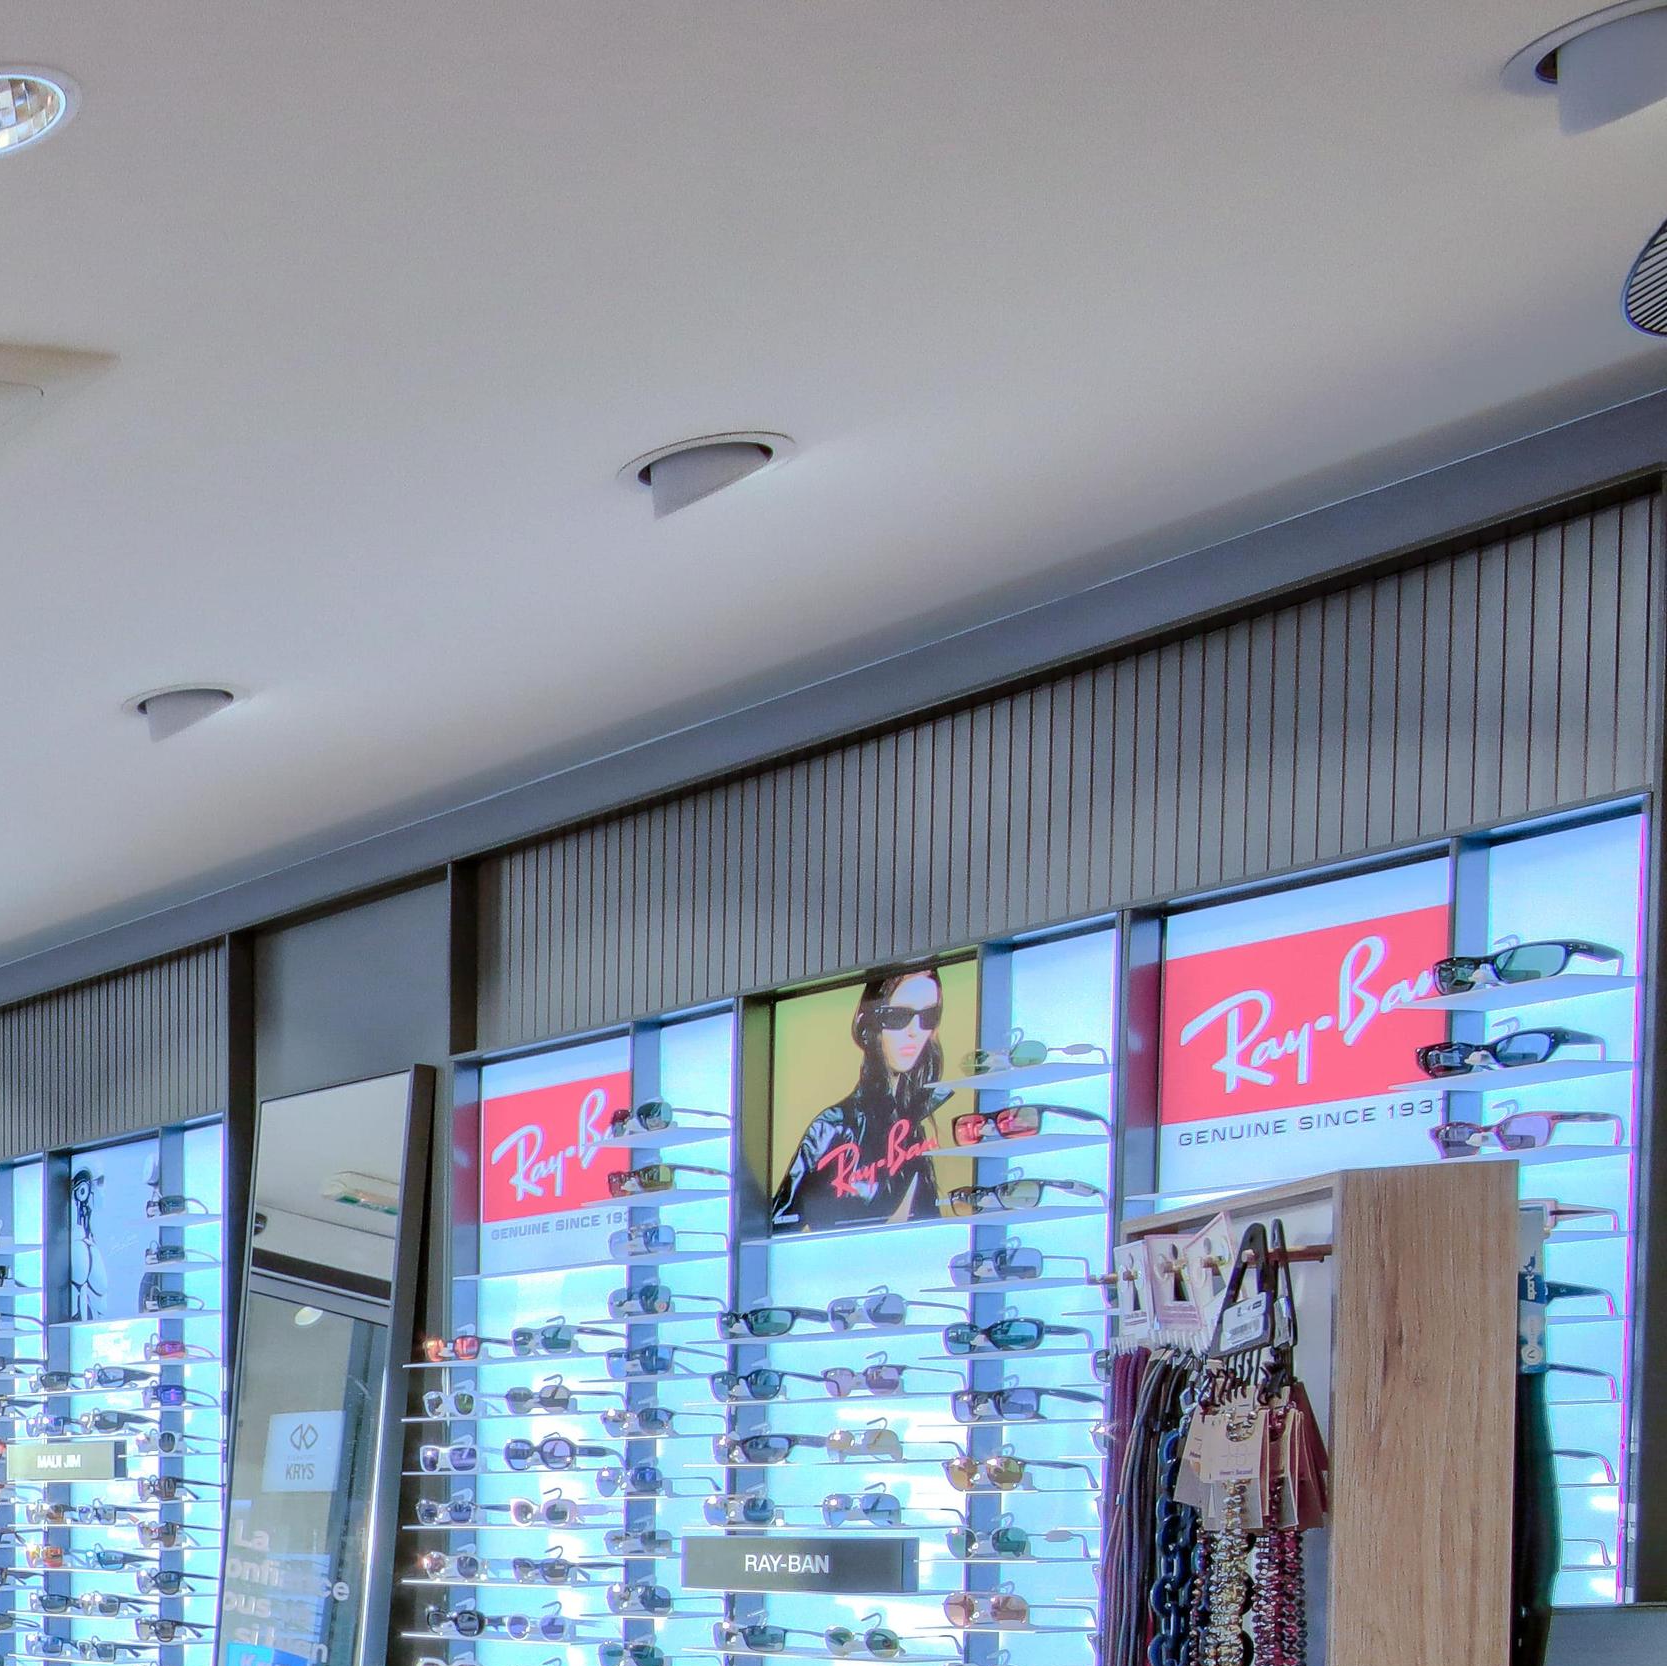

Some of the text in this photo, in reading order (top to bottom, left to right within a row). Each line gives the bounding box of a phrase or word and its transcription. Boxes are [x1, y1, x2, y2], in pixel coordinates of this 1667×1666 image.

[1178, 1119, 1288, 1148] GENUINE
[1298, 1106, 1377, 1131] SINCE
[491, 1088, 614, 1202] Ray-B
[816, 1119, 939, 1199] Ray-Ban
[490, 1210, 630, 1241] GENUINE SINCE 193
[37, 1453, 81, 1468] MAUI JIM
[285, 1463, 315, 1481] KRYS
[234, 1519, 269, 1550] La
[744, 1553, 829, 1575] RAY-BAN
[224, 1591, 271, 1618] ous
